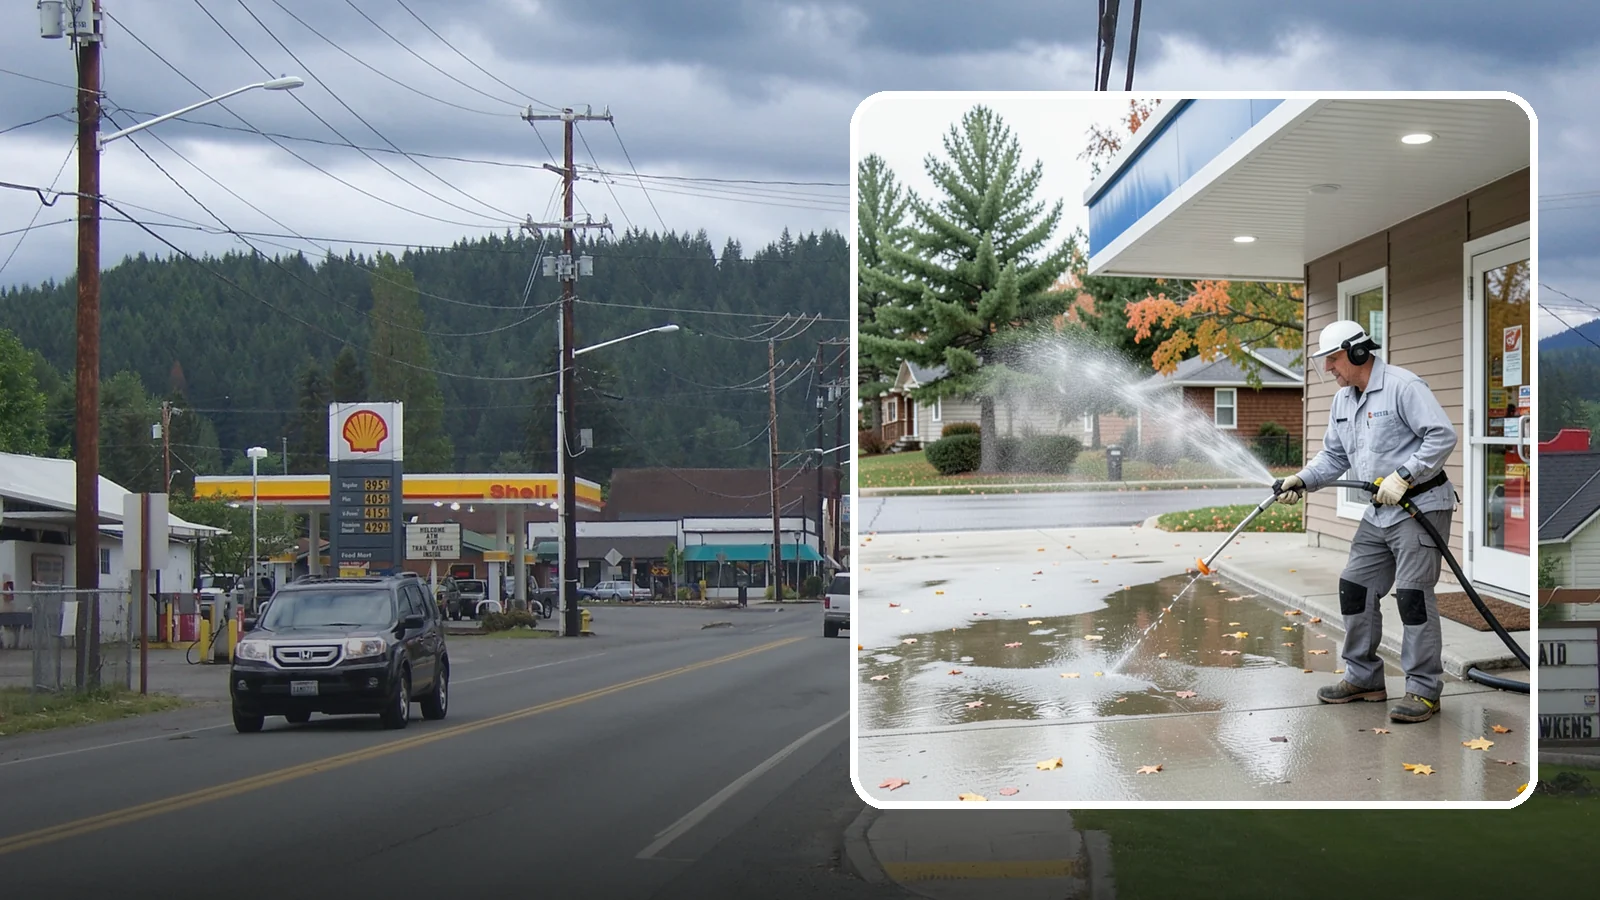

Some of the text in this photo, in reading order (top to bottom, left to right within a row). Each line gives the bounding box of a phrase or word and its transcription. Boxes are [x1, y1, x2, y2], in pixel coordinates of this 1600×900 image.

[365, 480, 384, 490] 395
[490, 484, 547, 499] Shell
[365, 494, 384, 504] 405
[365, 508, 384, 518] 415
[365, 522, 384, 533] 429
